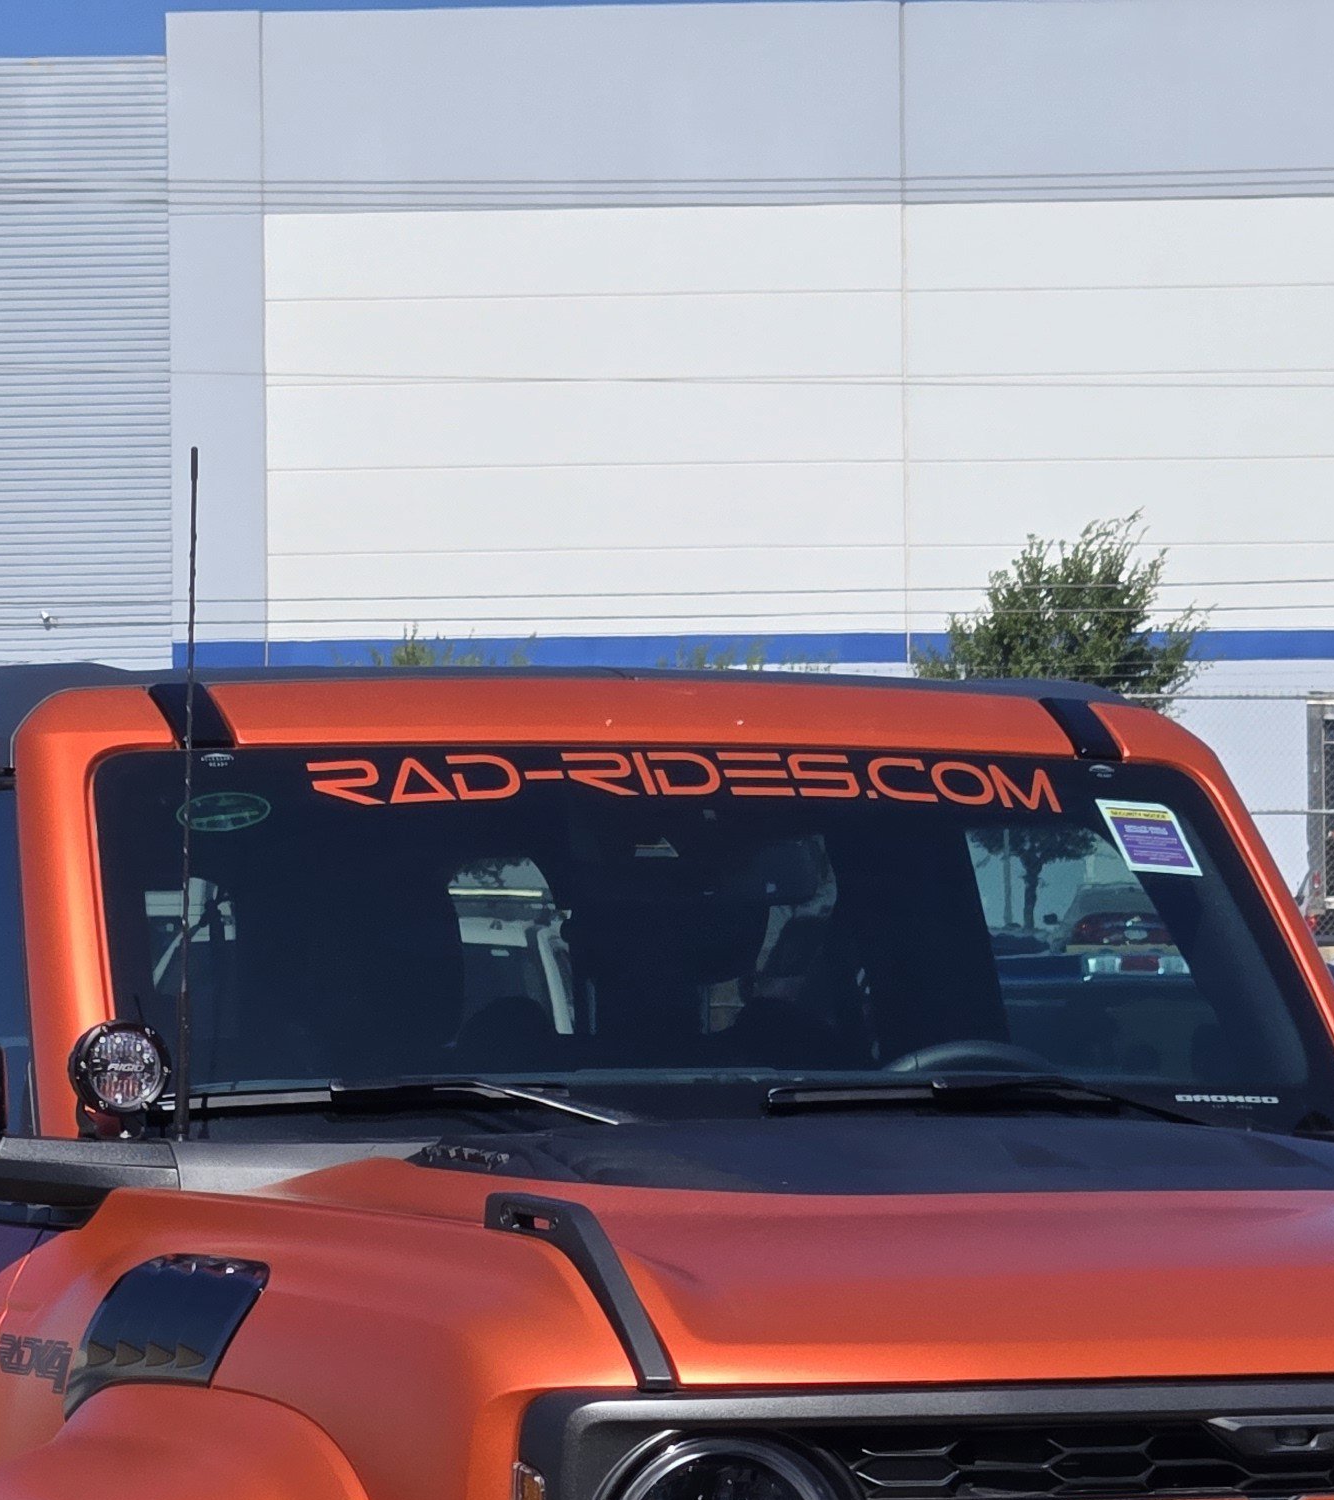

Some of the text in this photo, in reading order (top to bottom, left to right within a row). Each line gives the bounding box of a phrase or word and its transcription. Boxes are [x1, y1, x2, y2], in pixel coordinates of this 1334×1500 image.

[306, 752, 1063, 813] RAD-RIDES.COM
[107, 1063, 145, 1072] RIGID
[1175, 1094, 1280, 1104] BRONCO
